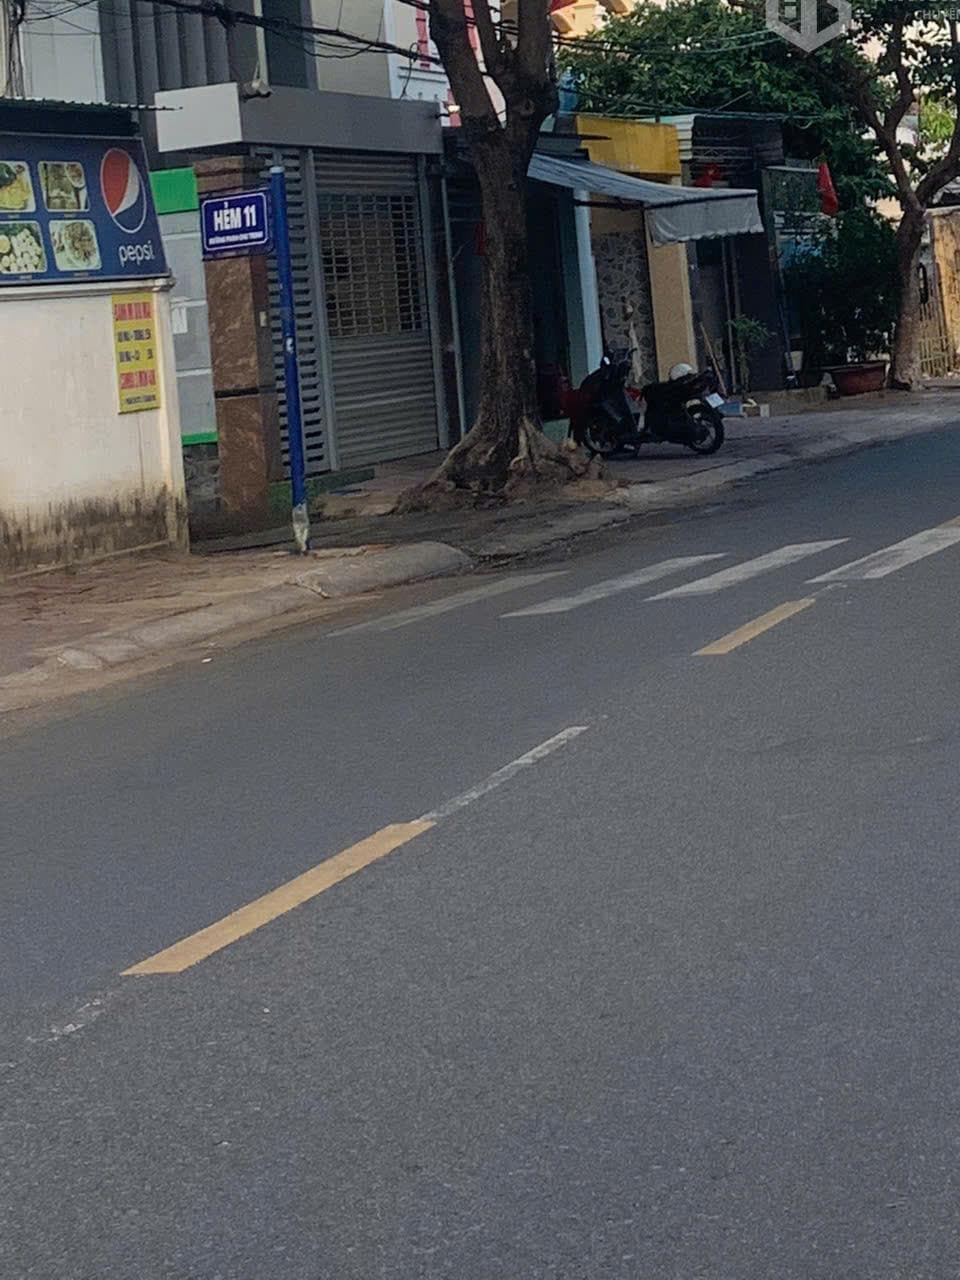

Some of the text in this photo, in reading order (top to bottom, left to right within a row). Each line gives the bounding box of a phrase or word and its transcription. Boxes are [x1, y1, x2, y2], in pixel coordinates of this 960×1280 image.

[214, 201, 257, 231] HẺM 11
[118, 240, 153, 267] pepsi
